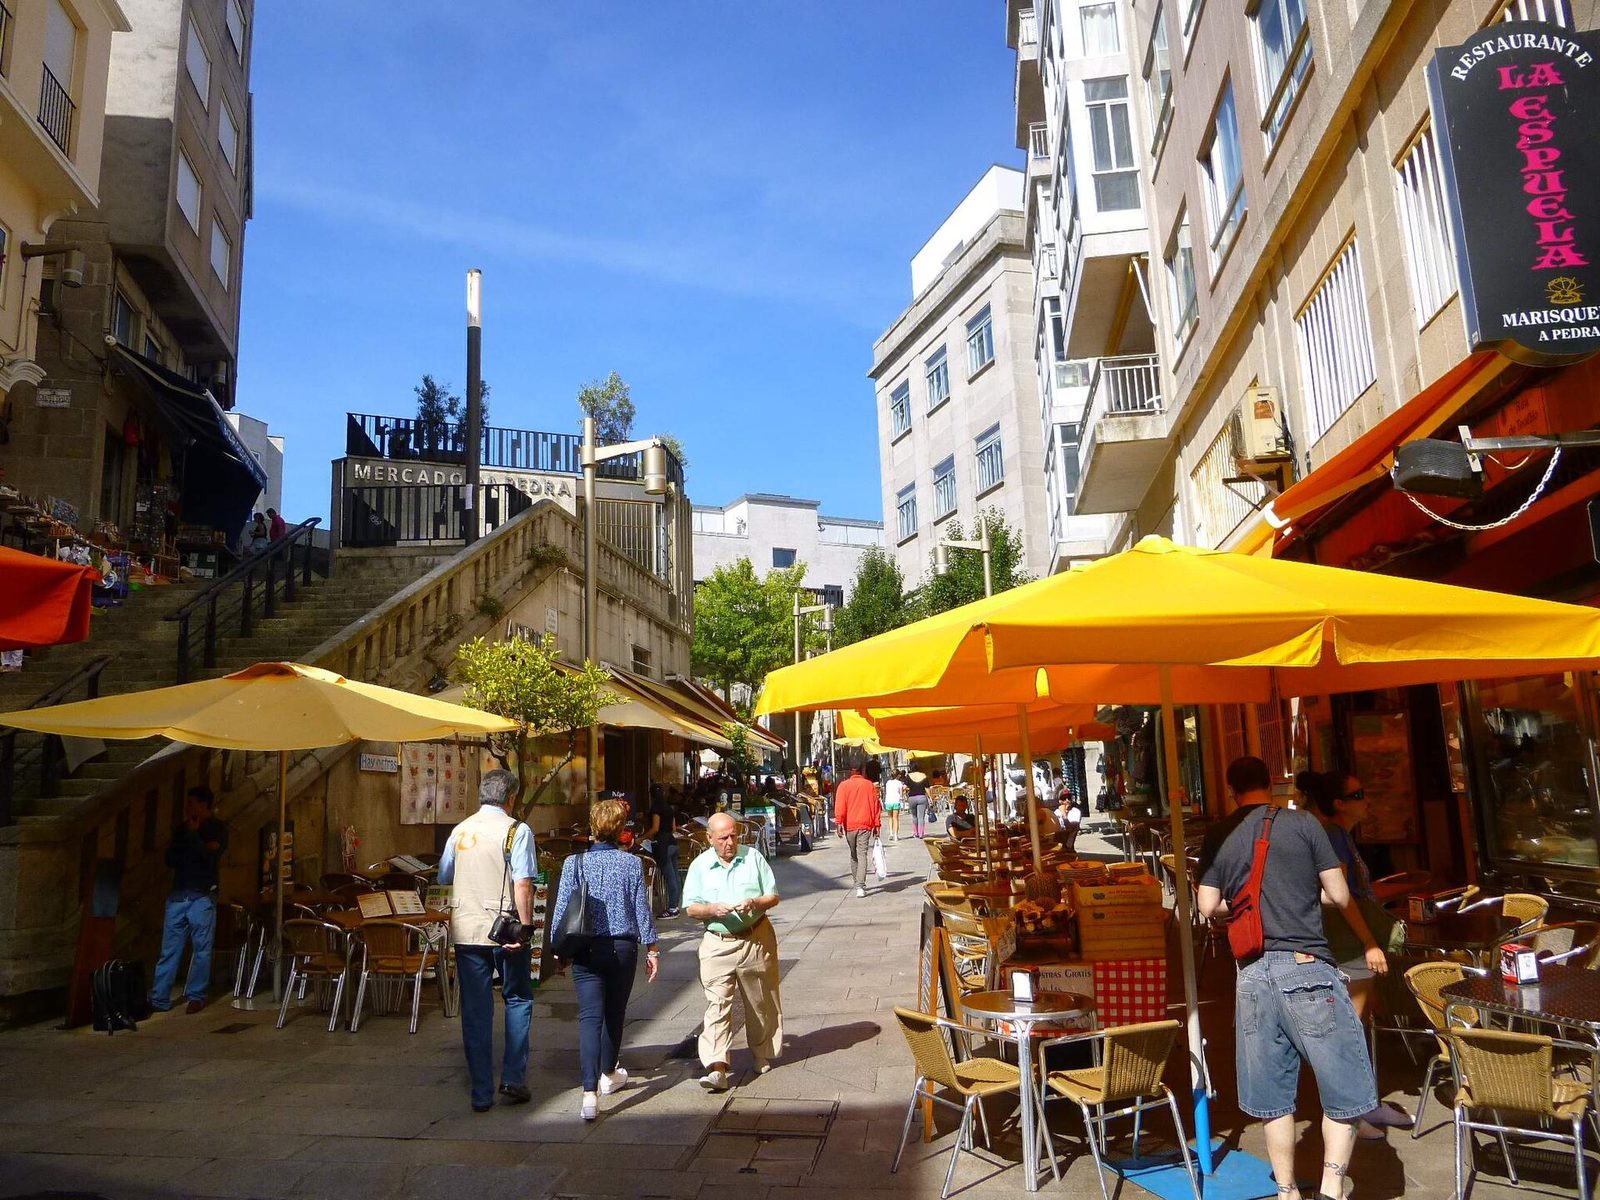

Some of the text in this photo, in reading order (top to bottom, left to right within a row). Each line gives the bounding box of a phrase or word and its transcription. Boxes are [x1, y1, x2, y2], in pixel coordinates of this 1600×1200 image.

[1450, 33, 1593, 81] RESTAURANTE
[1496, 62, 1565, 91] LA
[1508, 95, 1590, 271] ESPUELA
[1501, 306, 1600, 328] MARISQUE
[1538, 325, 1600, 342] A PEDRA
[354, 463, 464, 485] MERCADO
